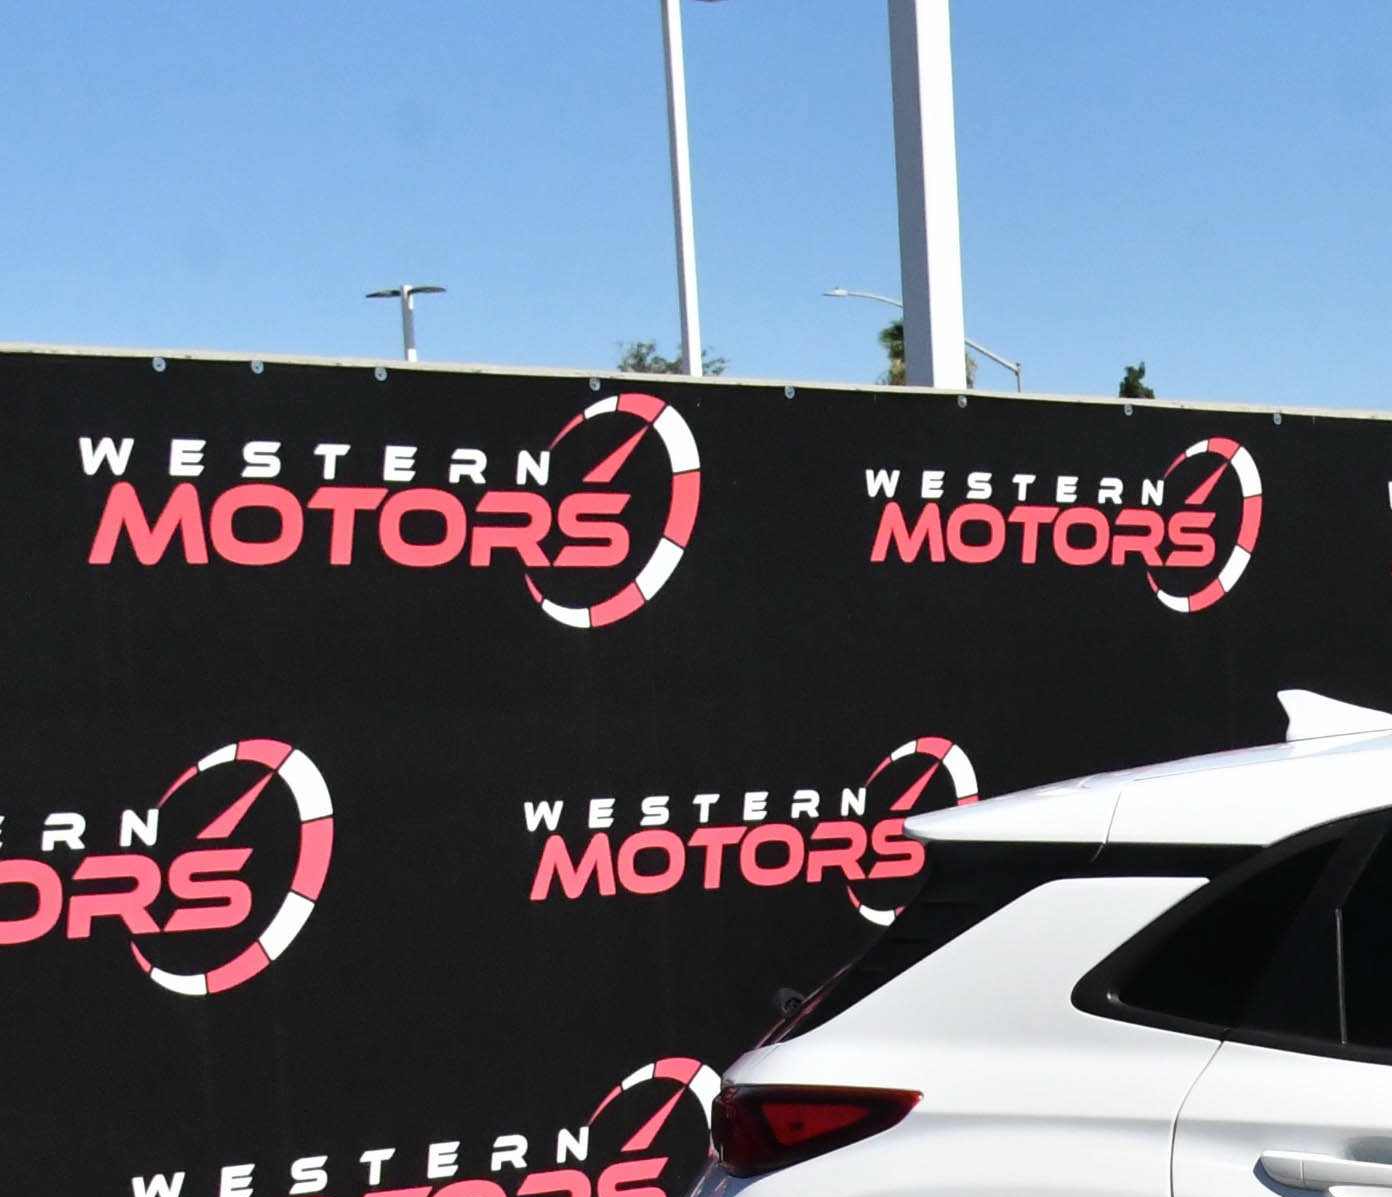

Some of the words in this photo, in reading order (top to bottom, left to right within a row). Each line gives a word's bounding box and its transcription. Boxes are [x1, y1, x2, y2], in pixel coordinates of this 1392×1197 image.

[79, 437, 551, 485] WESTERN
[866, 470, 1165, 506] WESTERN
[88, 482, 631, 568] MOTORS
[870, 502, 1217, 568] MOTORS
[0, 809, 159, 852] RN
[524, 788, 867, 832] WESTERN
[530, 818, 926, 901] MOTORS
